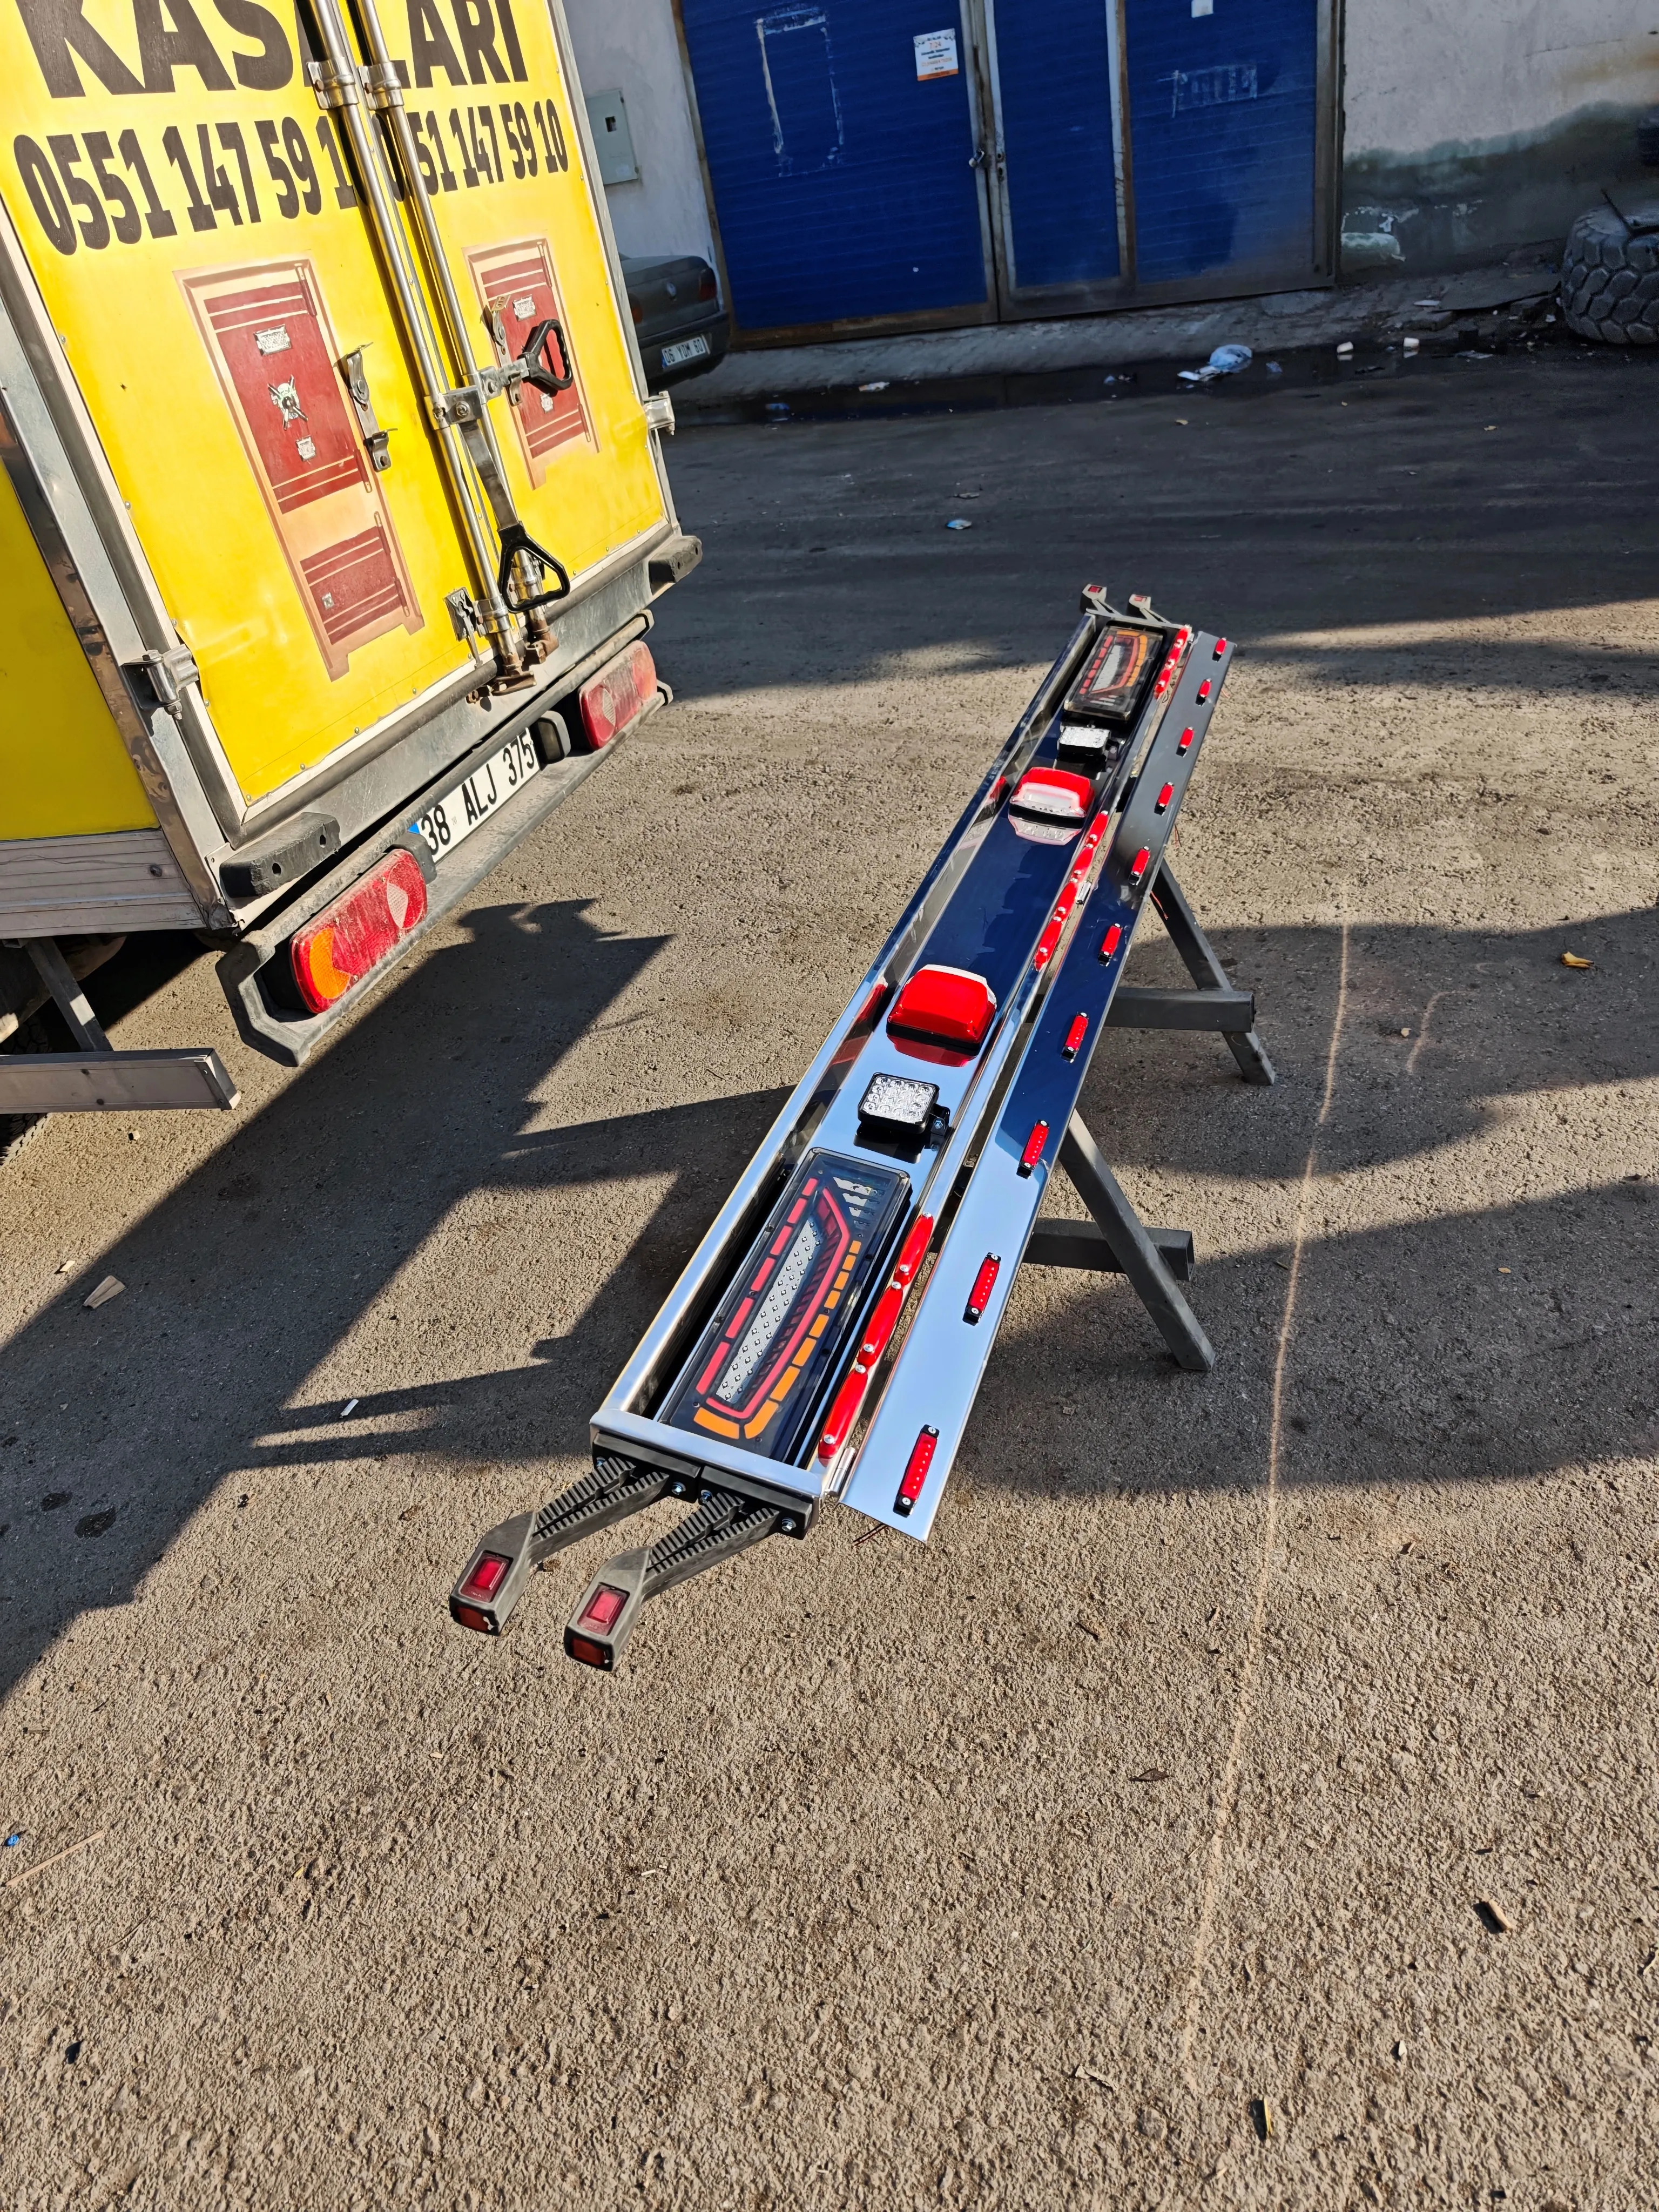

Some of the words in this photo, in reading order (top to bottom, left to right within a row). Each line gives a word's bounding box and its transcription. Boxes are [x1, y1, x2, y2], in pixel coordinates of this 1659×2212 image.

[14, 129, 178, 255] 0551
[162, 122, 261, 233] 147
[254, 116, 322, 219] 59
[371, 110, 458, 202] 051
[449, 105, 504, 188] 147
[499, 102, 538, 180] 59
[534, 98, 569, 173] 10
[664, 348, 676, 363] 06
[421, 804, 451, 855] 38
[461, 763, 497, 826] ALJ
[503, 732, 535, 786] 375
